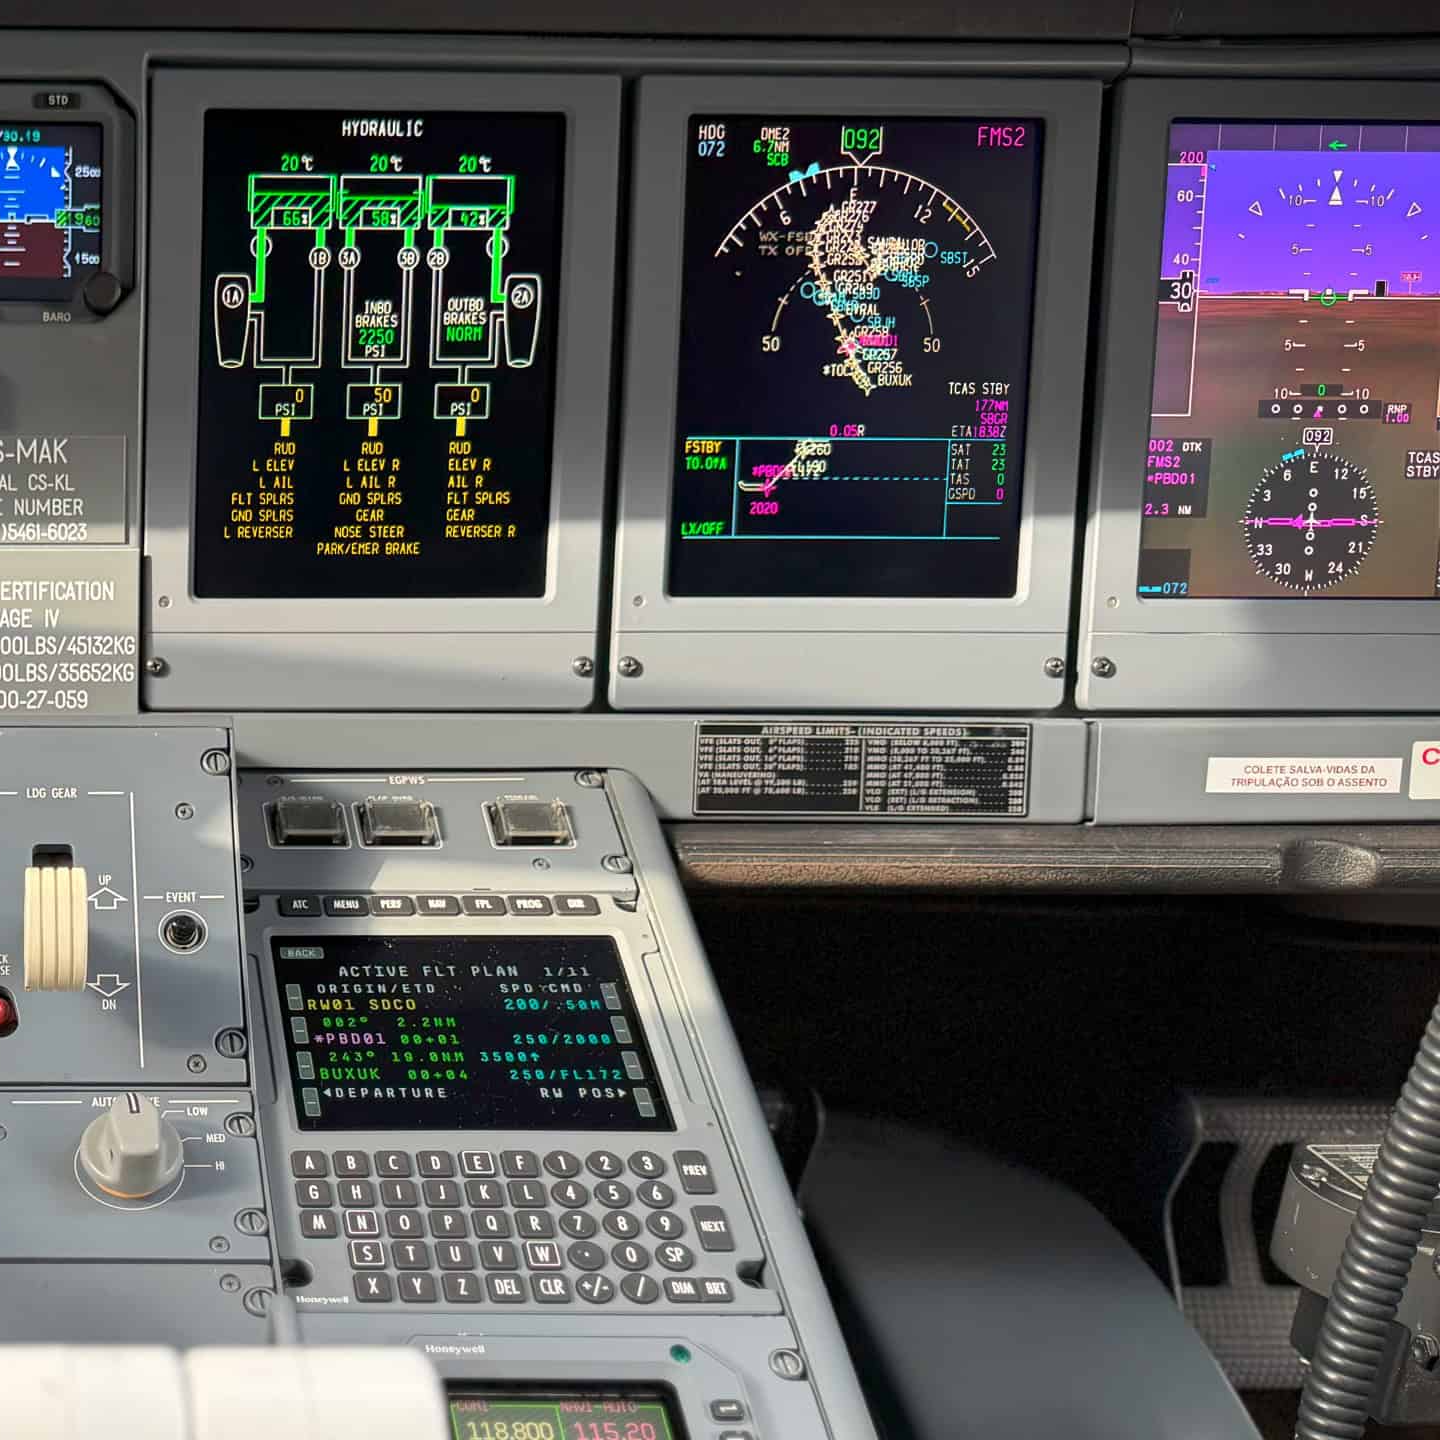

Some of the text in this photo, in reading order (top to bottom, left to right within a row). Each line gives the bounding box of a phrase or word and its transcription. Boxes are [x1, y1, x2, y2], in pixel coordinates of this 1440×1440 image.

[49, 96, 68, 105] STD
[343, 121, 423, 136] HYDRAULIC
[699, 125, 725, 140] HDG
[844, 131, 879, 148] 092
[978, 127, 1024, 146] FMS2
[699, 142, 724, 156] 072
[43, 312, 71, 321] BARO
[355, 315, 398, 327] BRAKES
[444, 312, 486, 325] BRAKES
[359, 330, 394, 345] 2250
[447, 326, 481, 341] NORM
[949, 383, 1010, 395] TCAS STBY
[274, 443, 295, 454] RUD
[685, 442, 721, 453] FSTBY
[1147, 456, 1180, 468] FMS2
[28, 475, 74, 491] CS-KL
[232, 494, 294, 505] FLT SPLRS
[339, 493, 402, 505] GND SPLRS
[14, 499, 83, 515] NUMBER
[750, 502, 779, 515] 2020
[356, 510, 383, 522] GEAR
[335, 527, 404, 538] NOSE STEER
[682, 523, 722, 535] LX/OFF
[317, 543, 420, 555] PARK/EMER BRAKE
[1163, 581, 1188, 593] 072
[45, 609, 59, 627] IV
[762, 727, 812, 735] AIRSPEED
[1244, 766, 1375, 774] COLETE SALVA-VIDAS DA
[389, 776, 424, 785] EGPWS
[1231, 777, 1387, 788] TRIPULAÇÃO SOB O ASSENTO
[26, 788, 77, 798] LDG GEAR
[99, 875, 111, 885] UP
[166, 892, 196, 903] EVENT
[339, 966, 589, 977] ACTIVE FLT PLAN 1/11
[317, 984, 435, 993] ORIGIN/ETD
[102, 1000, 116, 1010] DN
[308, 999, 355, 1011] RW01
[513, 1034, 611, 1044] 250/2000
[320, 1068, 380, 1080] BUXUK
[510, 1068, 622, 1080] 250/FL172
[335, 1087, 447, 1098] DEPARTURE
[540, 1087, 615, 1098] RW POS
[187, 1106, 207, 1116] LOW
[206, 1133, 225, 1143] MED
[683, 1164, 707, 1177] PREV
[701, 1219, 725, 1233] NEXT
[668, 1247, 684, 1263] SP
[495, 1279, 520, 1295] DEL
[540, 1279, 563, 1295] CLR
[296, 1295, 349, 1304] Honeywell
[425, 1344, 485, 1354] Honeywell
